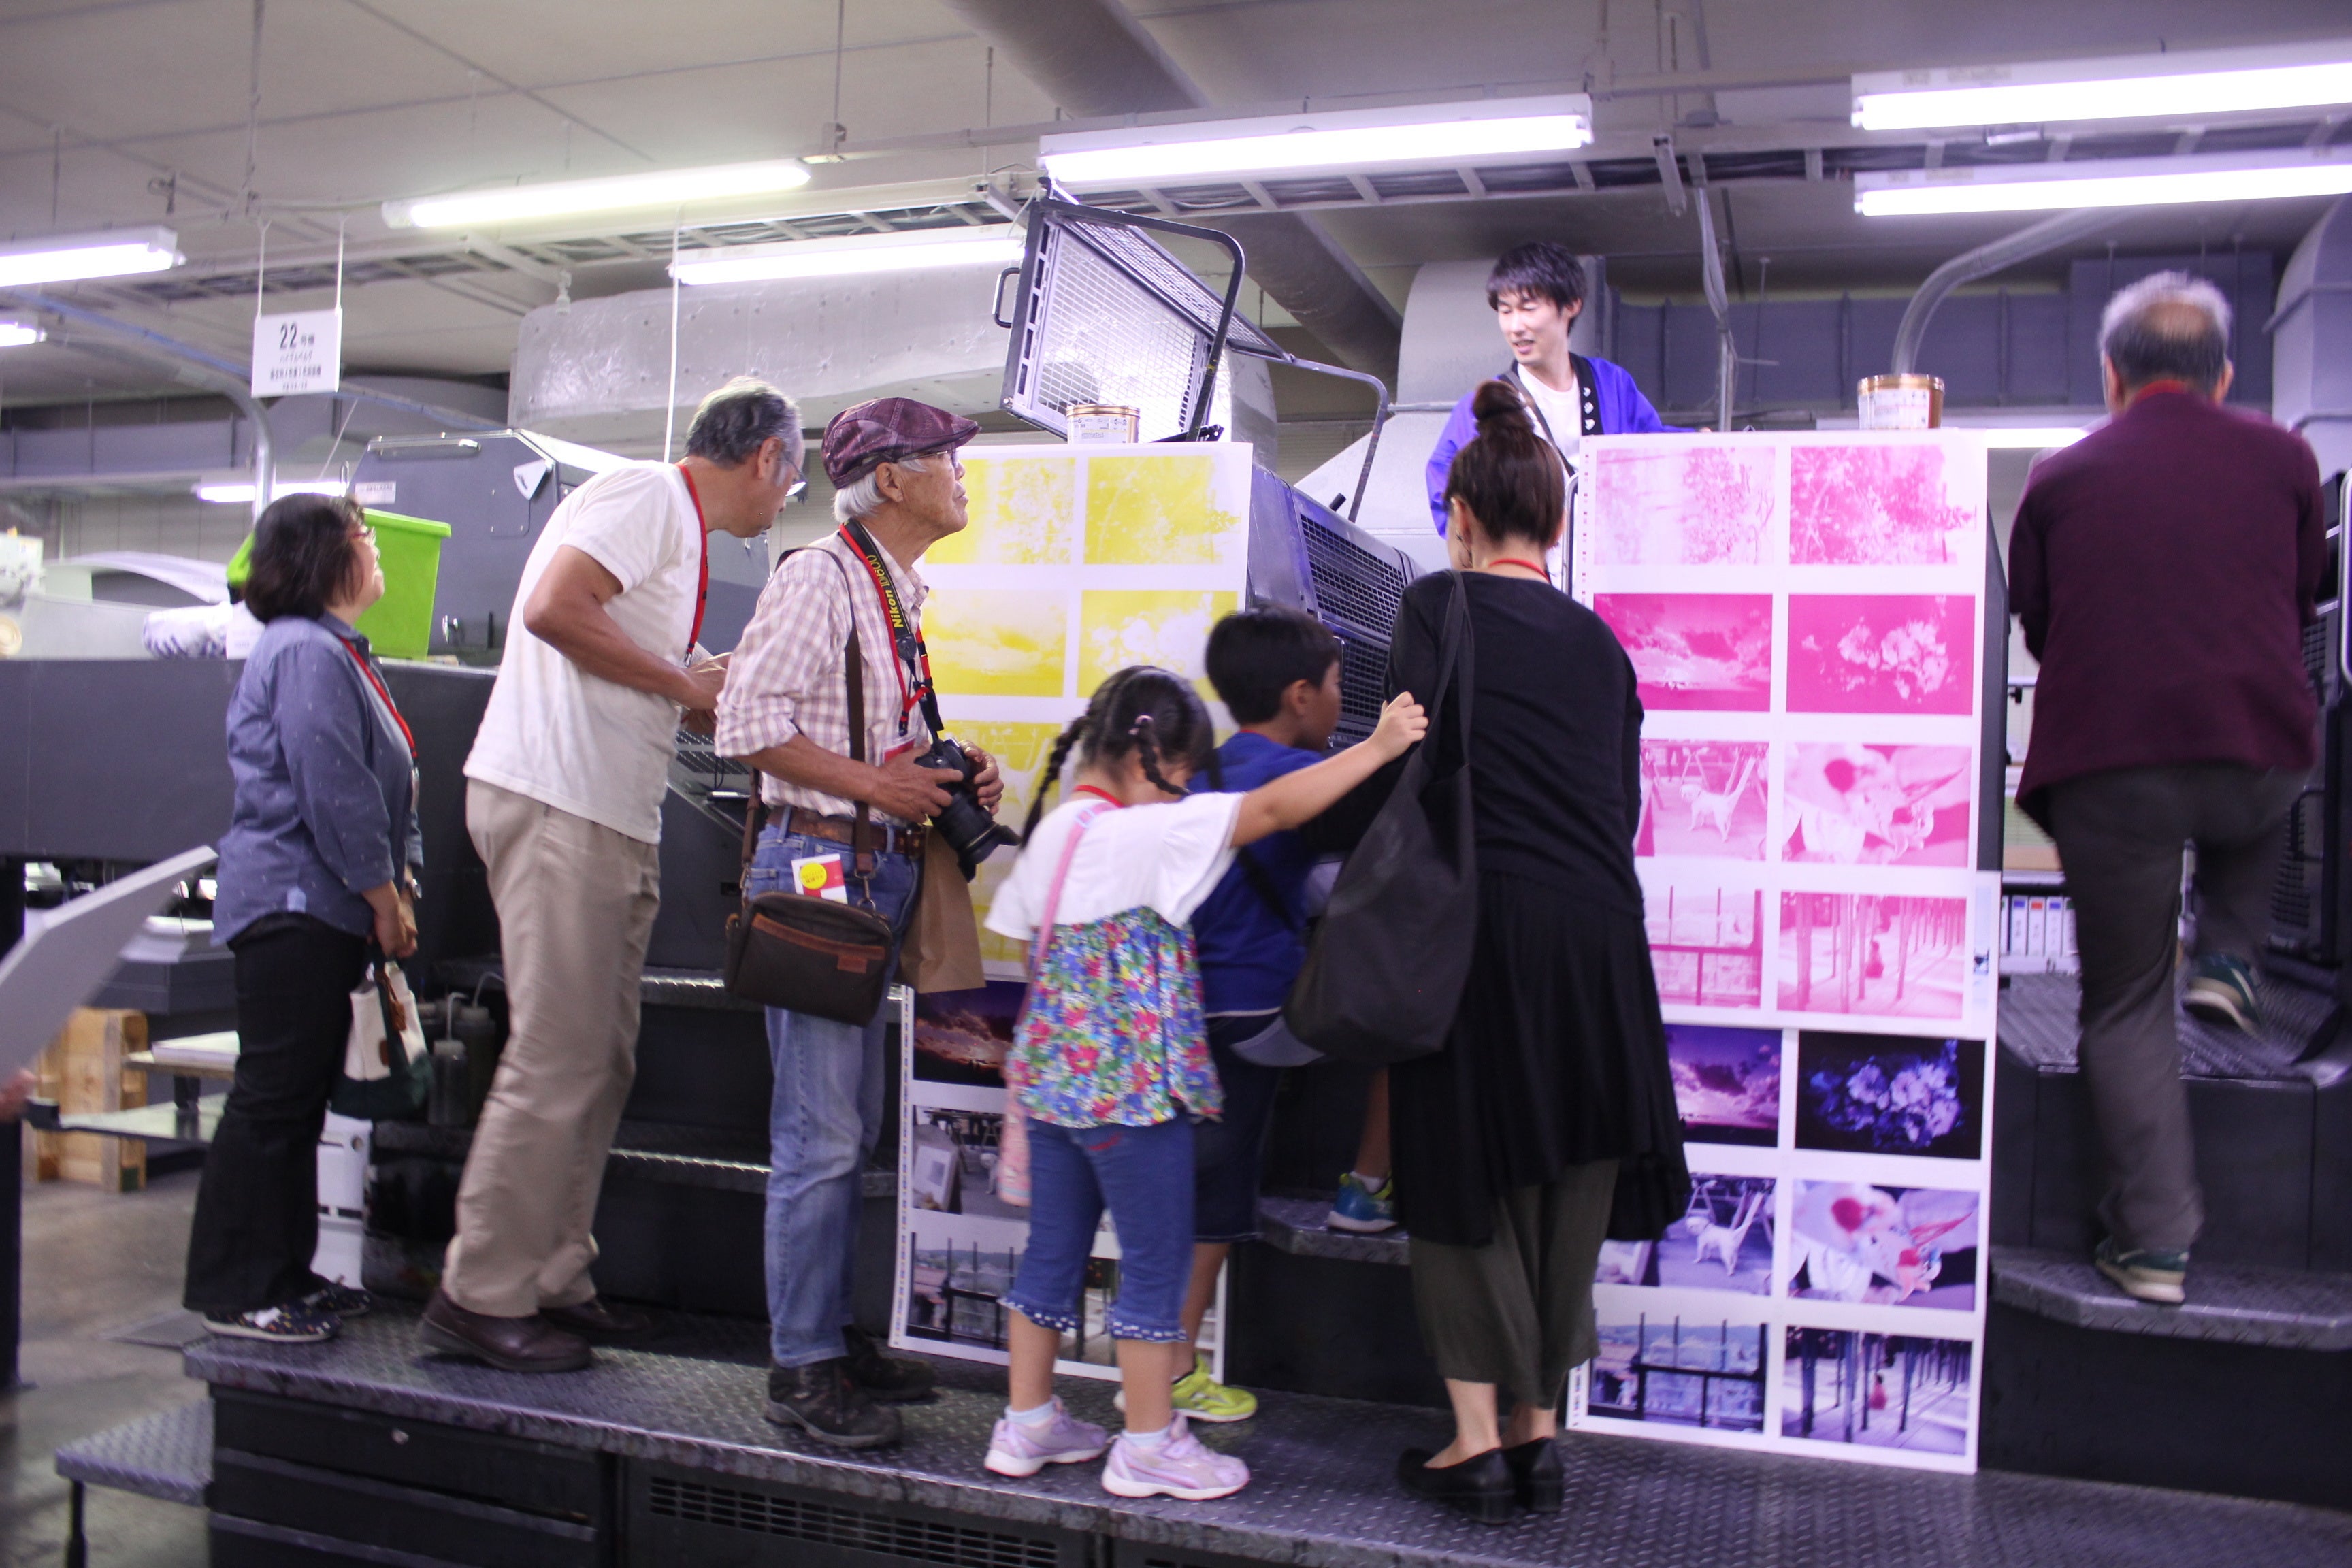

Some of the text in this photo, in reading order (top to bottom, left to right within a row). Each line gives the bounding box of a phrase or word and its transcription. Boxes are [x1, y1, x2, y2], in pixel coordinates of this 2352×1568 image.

[280, 323, 297, 349] 22
[866, 555, 904, 627] Nikon D600
